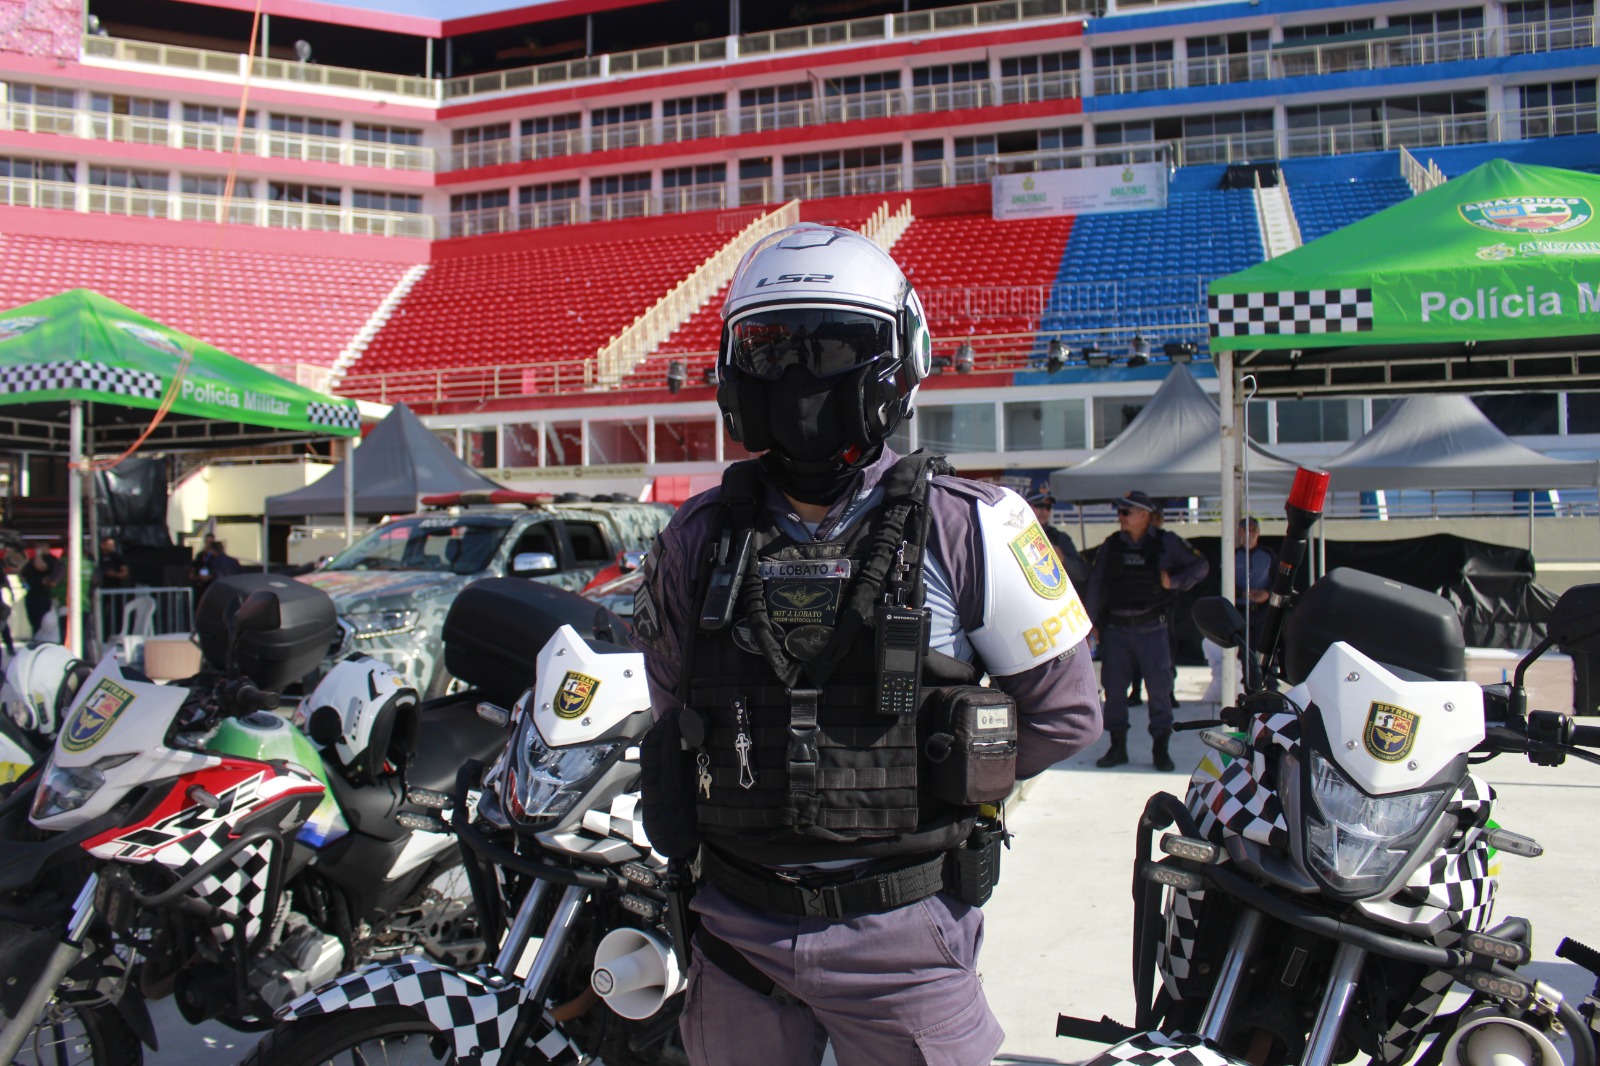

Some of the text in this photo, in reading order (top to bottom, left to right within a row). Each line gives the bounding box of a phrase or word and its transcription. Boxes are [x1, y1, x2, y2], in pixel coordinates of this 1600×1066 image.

[1465, 198, 1580, 212] AMAZONAS
[756, 273, 835, 289] LS2
[1420, 286, 1562, 322] Polícia
[243, 389, 291, 415] Militar
[765, 565, 774, 576] J.
[779, 564, 829, 576] LOBATO
[794, 610, 823, 619] LOBATO
[1377, 704, 1414, 721] BPTRAN
